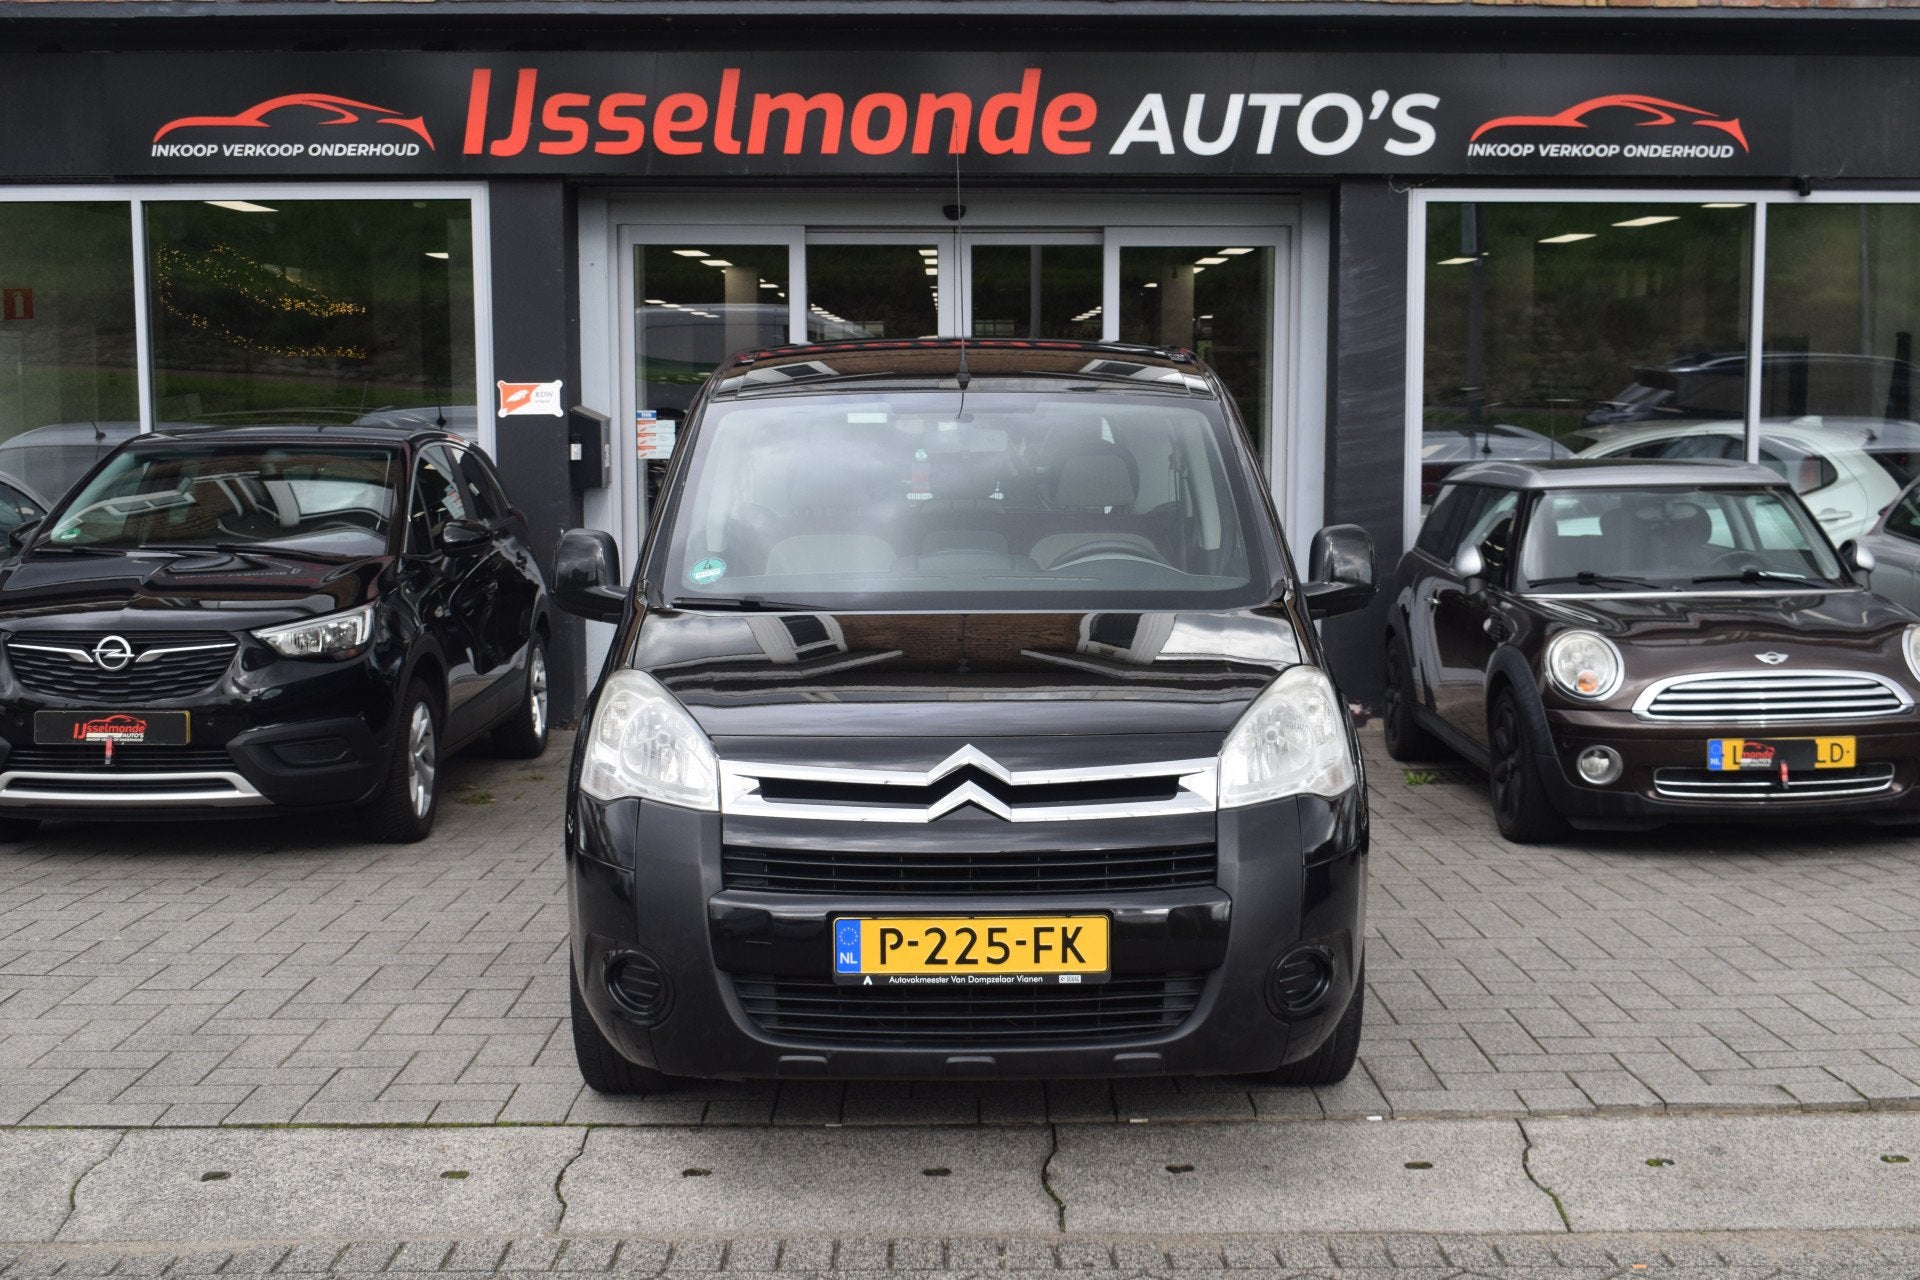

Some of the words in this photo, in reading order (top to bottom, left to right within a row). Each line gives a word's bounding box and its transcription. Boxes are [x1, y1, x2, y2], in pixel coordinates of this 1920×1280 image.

[462, 68, 1097, 157] IJsselmonde
[1108, 89, 1440, 157] AUTO'S
[151, 143, 218, 157] INKOOP
[222, 143, 304, 157] VERKOOP
[308, 143, 420, 157] ONDERHOUD
[1467, 143, 1534, 157] INKOOP
[1538, 144, 1620, 158] VERKOOP
[1623, 144, 1734, 159] ONDERHOUD
[879, 926, 1087, 965] P-225-FK
[839, 952, 858, 964] NL
[888, 975, 950, 984] Autovakmeester
[951, 975, 966, 984] Van
[968, 975, 1015, 985] Dompzelaar
[1017, 974, 1043, 983] Vianen
